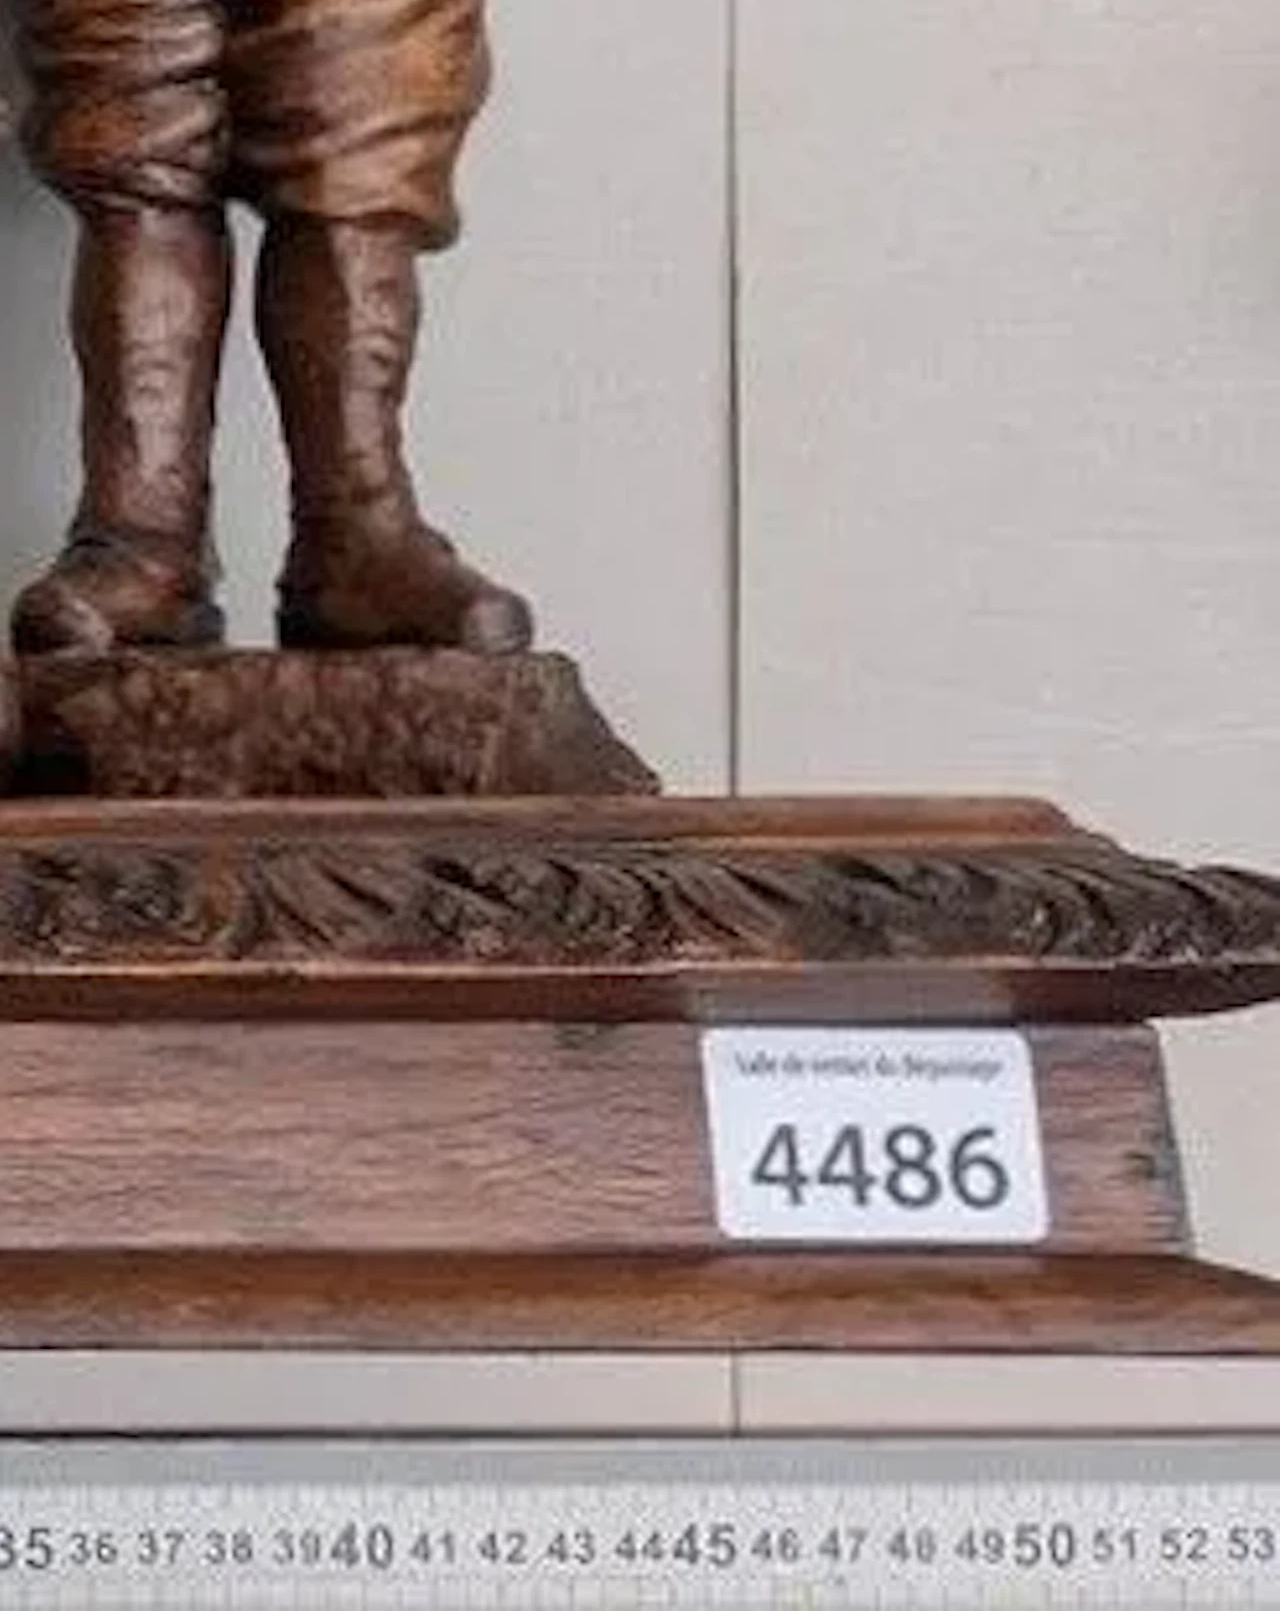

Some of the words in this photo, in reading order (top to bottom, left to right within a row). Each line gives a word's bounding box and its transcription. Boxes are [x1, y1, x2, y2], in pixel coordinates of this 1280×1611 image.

[750, 1123, 1011, 1211] 4486
[70, 1532, 118, 1566] 36
[138, 1531, 184, 1565] 37
[205, 1531, 254, 1565] 38
[276, 1530, 321, 1563] 39
[330, 1523, 394, 1570] 40
[410, 1532, 455, 1563] 41
[479, 1531, 526, 1564] 42
[546, 1530, 596, 1565] 43
[614, 1531, 664, 1561] 44
[672, 1522, 738, 1568] 45
[751, 1529, 799, 1561] 46
[819, 1529, 866, 1561] 47
[888, 1528, 936, 1563] 48
[955, 1528, 1005, 1561] 49
[1015, 1521, 1076, 1569] 50
[1094, 1528, 1136, 1560] 51
[1160, 1527, 1208, 1562] 52
[1228, 1527, 1275, 1562] 53
